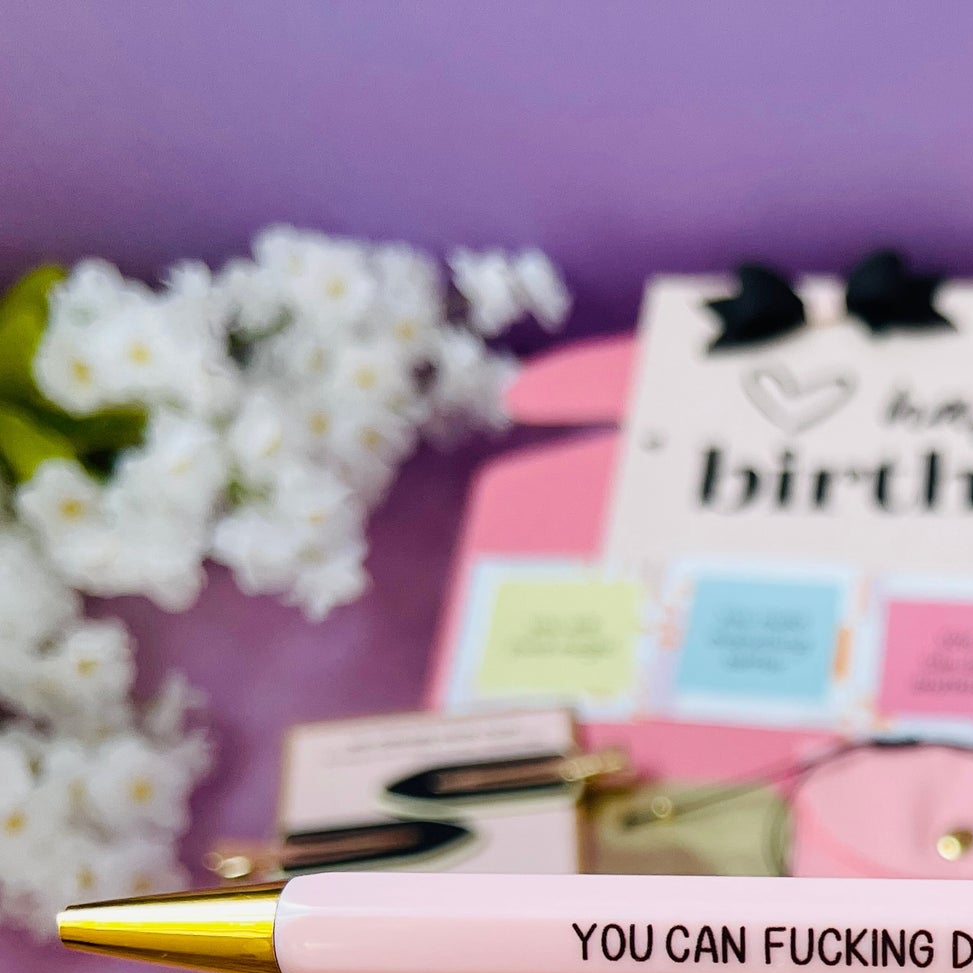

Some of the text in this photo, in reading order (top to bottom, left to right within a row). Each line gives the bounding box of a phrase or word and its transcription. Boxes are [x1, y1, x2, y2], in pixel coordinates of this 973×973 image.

[570, 922, 655, 964] YOU
[664, 923, 747, 965] CAN
[763, 925, 935, 970] FUCKING
